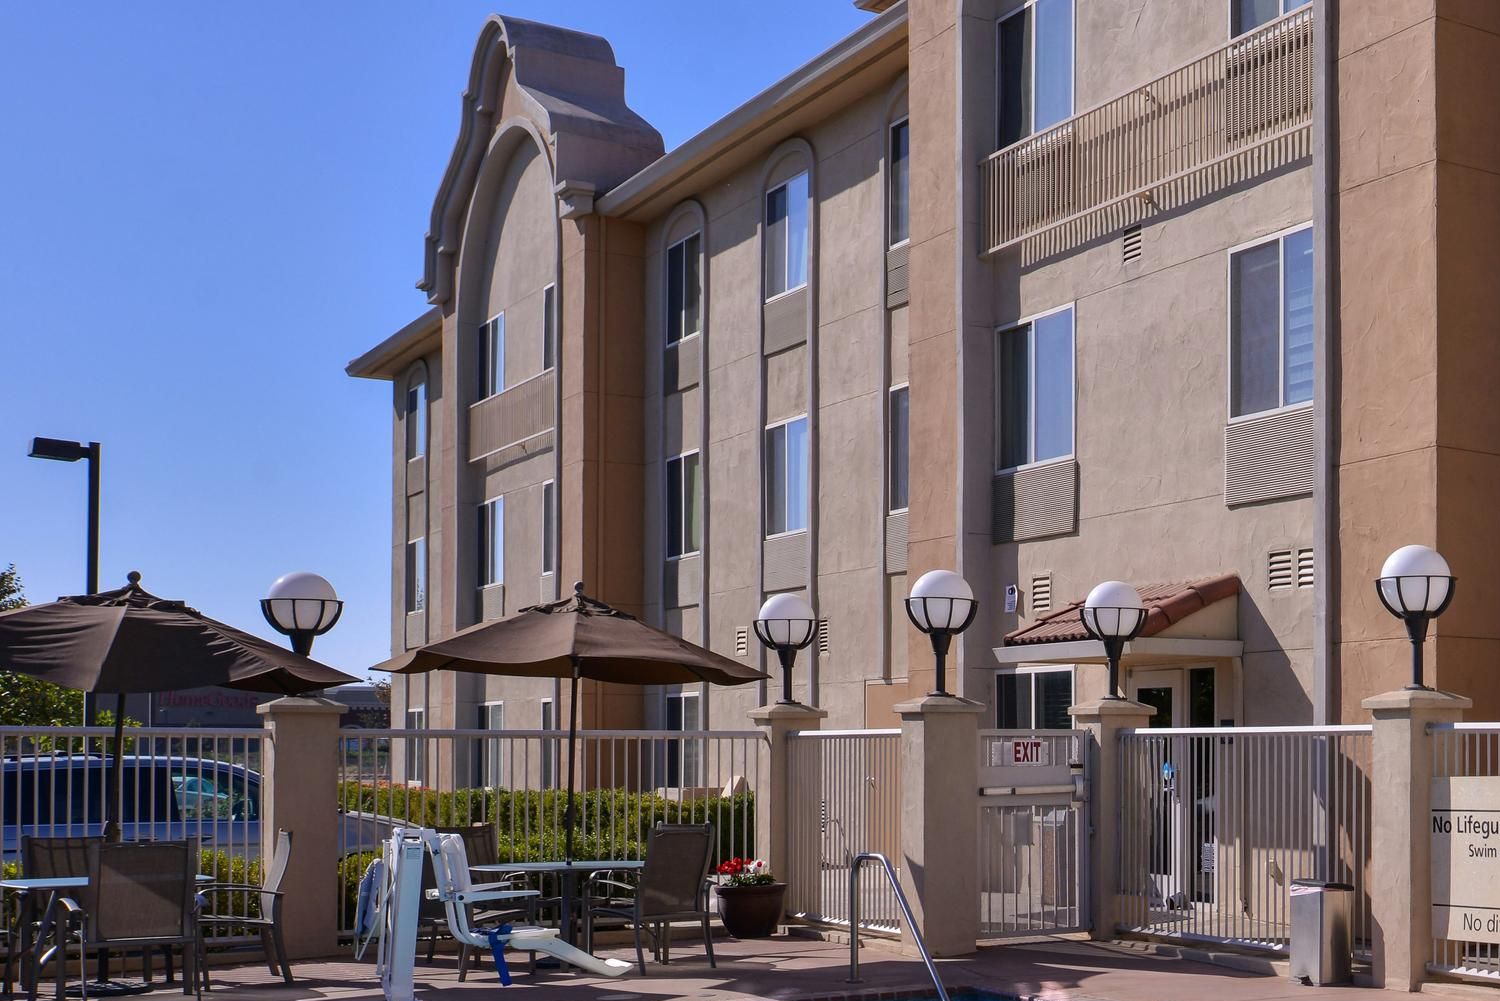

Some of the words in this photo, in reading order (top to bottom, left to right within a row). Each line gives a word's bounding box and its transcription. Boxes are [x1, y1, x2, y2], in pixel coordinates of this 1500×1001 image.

[1014, 741, 1041, 763] EXIT
[1432, 815, 1452, 834] No
[1469, 843, 1497, 858] Swim
[1463, 912, 1482, 932] No
